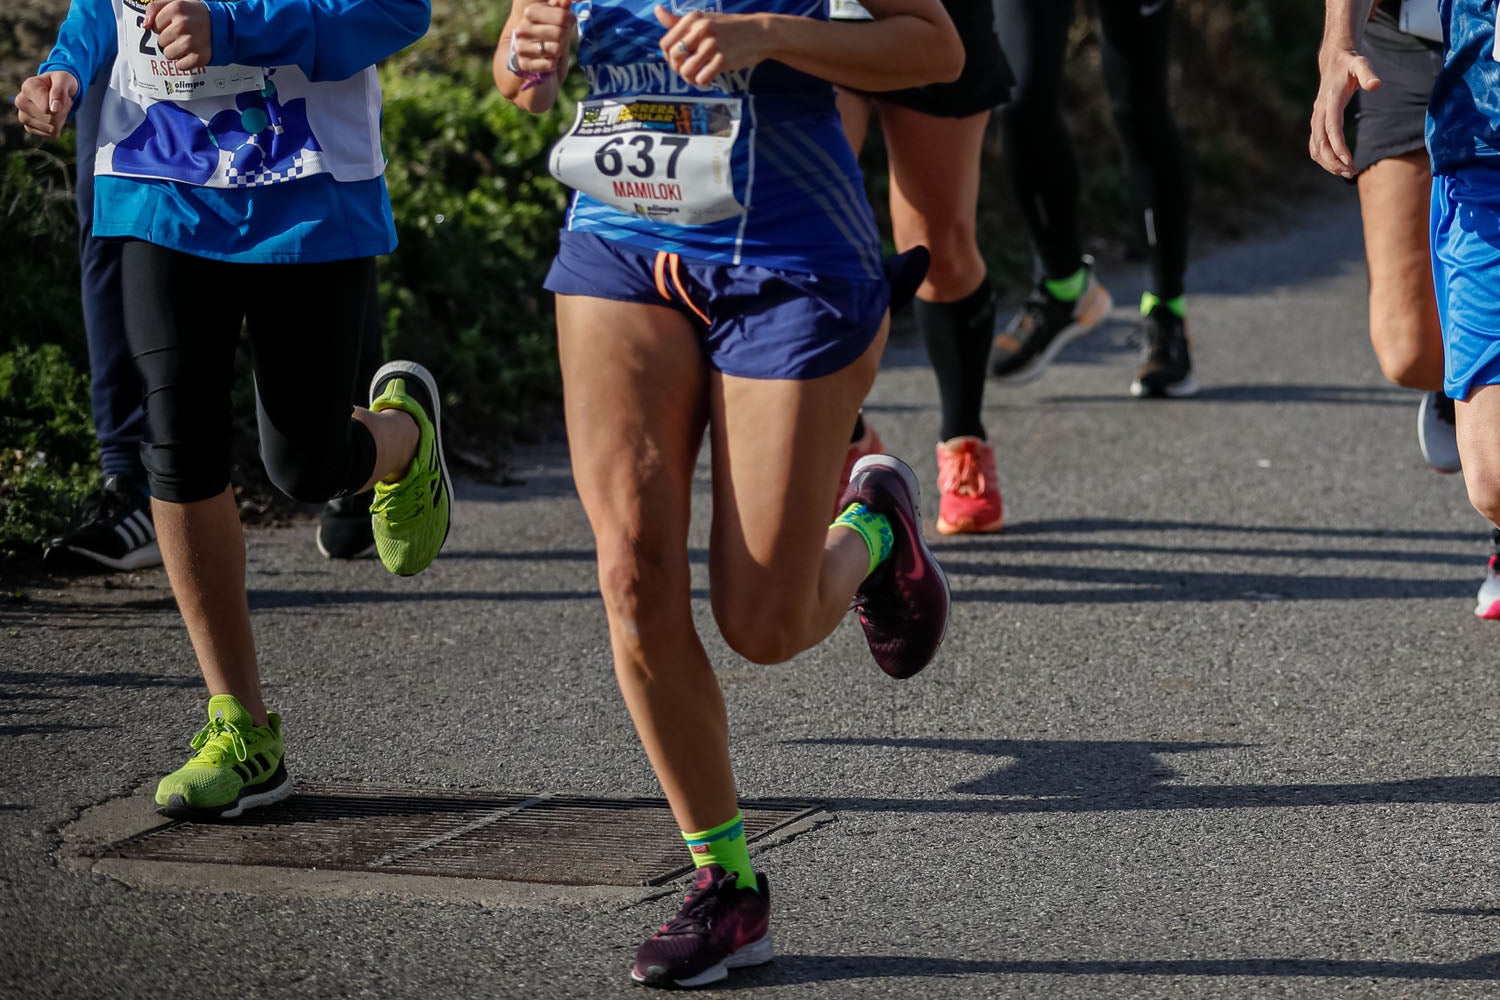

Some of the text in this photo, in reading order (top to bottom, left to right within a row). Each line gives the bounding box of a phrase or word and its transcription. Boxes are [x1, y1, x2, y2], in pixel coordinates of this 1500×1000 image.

[175, 80, 205, 89] olimpo
[594, 135, 690, 180] 637
[612, 180, 683, 200] MAMILOKI
